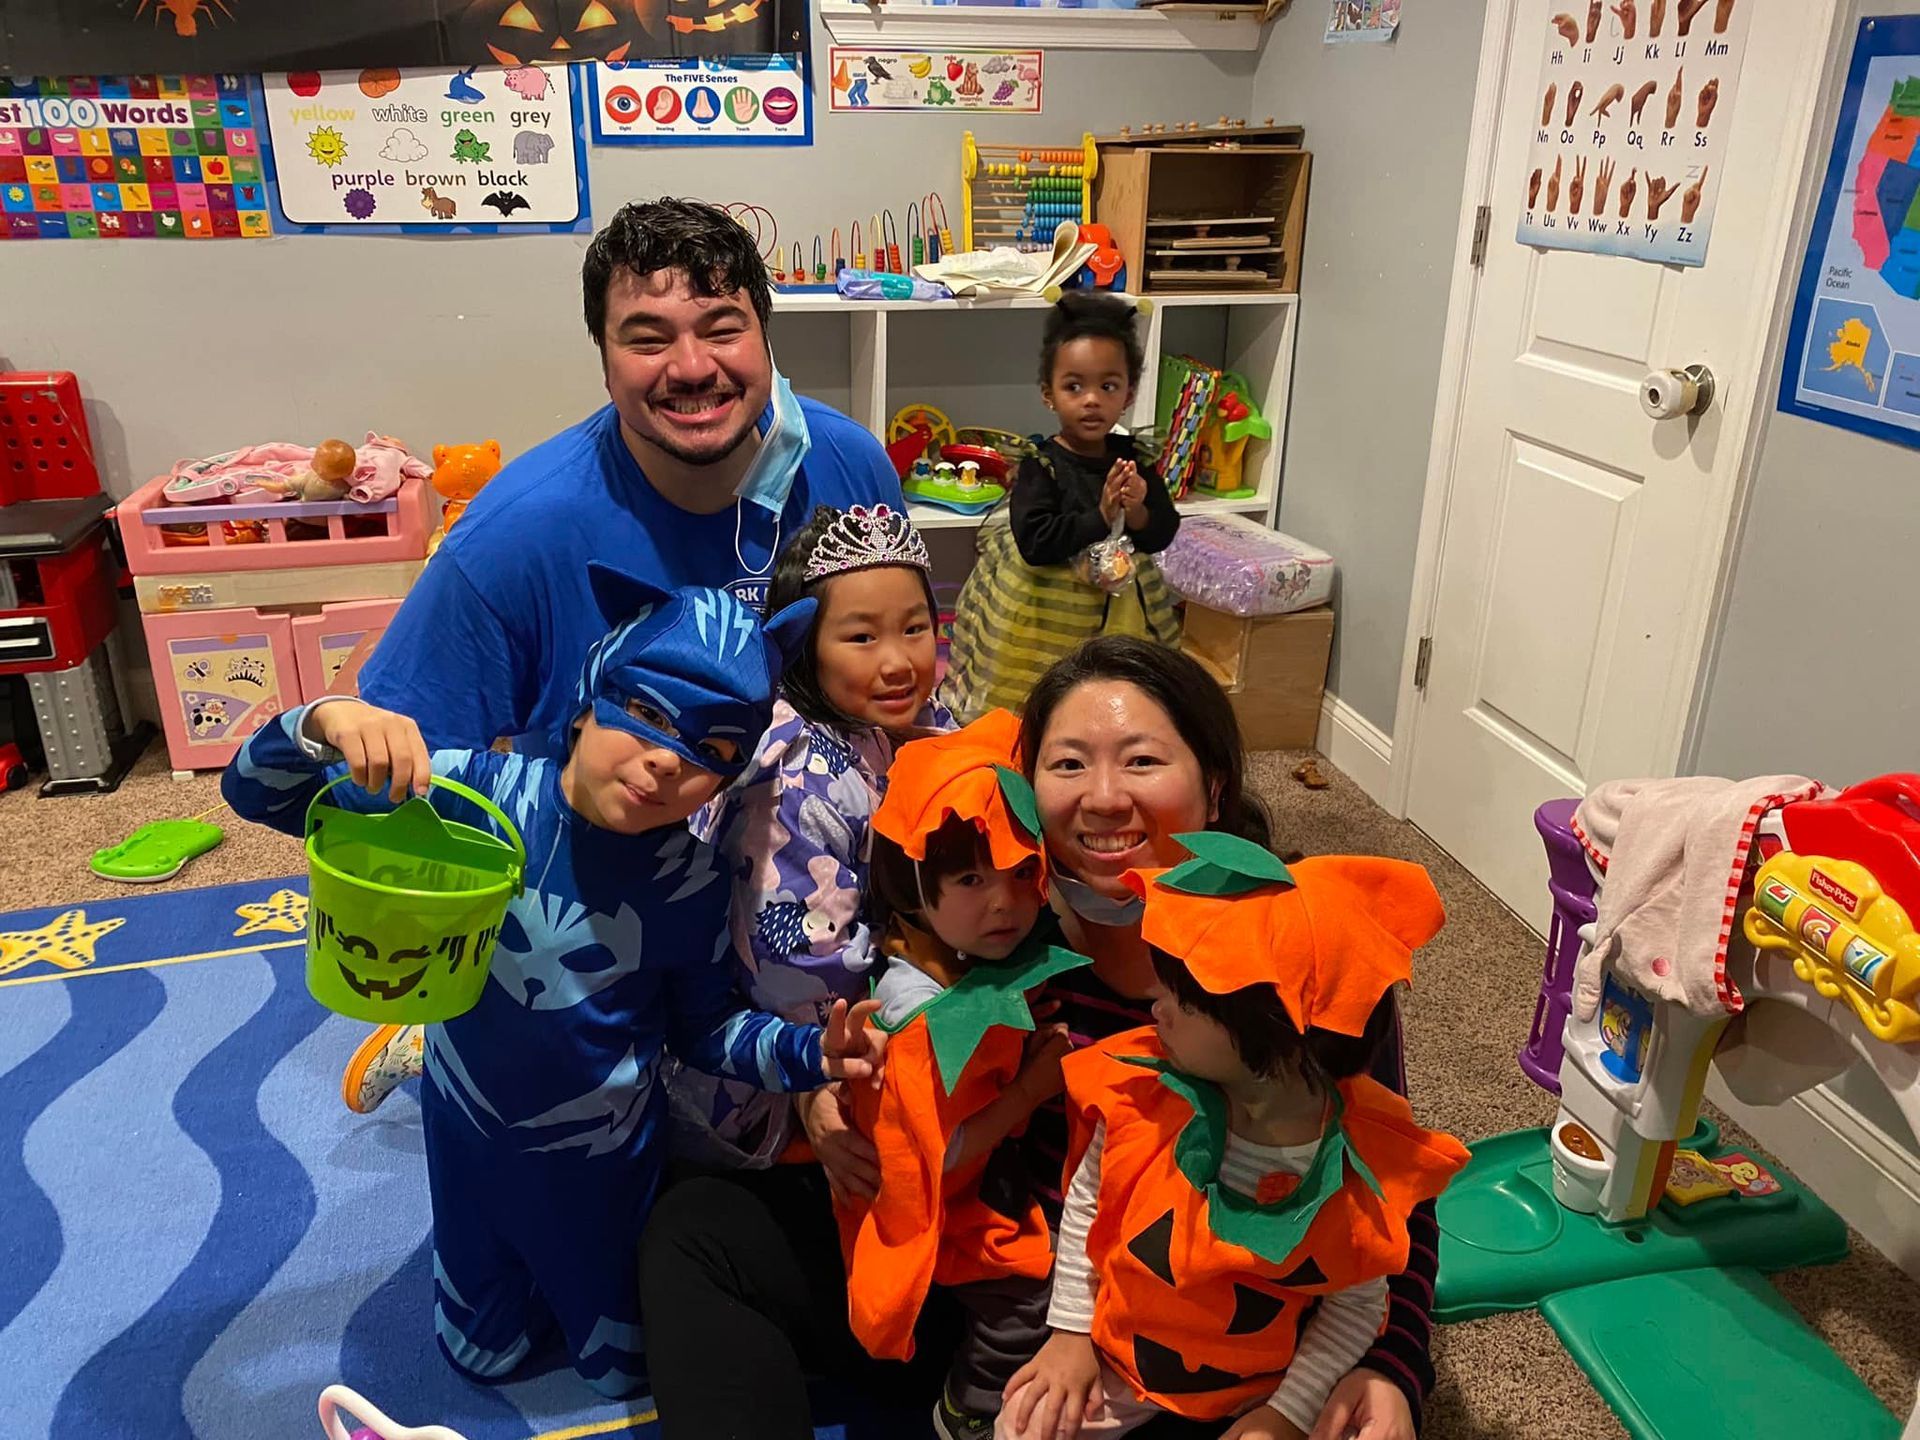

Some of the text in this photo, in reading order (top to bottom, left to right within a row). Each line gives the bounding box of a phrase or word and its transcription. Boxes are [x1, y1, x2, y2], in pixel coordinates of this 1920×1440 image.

[1550, 50, 1563, 65] Hh
[1583, 48, 1591, 63] Ii
[1612, 46, 1625, 65] Jj
[1644, 43, 1660, 60] Kk
[1704, 40, 1729, 56] Mm
[664, 73, 738, 83] The FIVE Senses
[24, 97, 98, 129] 100
[100, 103, 189, 124] Words
[289, 104, 551, 128] yellow white green grey
[1537, 129, 1708, 149] Nn Oo Pp Qq Rr Ss
[331, 169, 529, 189] purple brown black
[1543, 213, 1556, 228] Uu
[1567, 216, 1579, 230] Vv
[1588, 218, 1608, 233] Ww
[1615, 221, 1630, 236] Xx
[1644, 223, 1659, 243] Yy
[1677, 226, 1693, 243] Zz
[1827, 265, 1853, 279] Pacific
[1825, 277, 1851, 290] Ocean
[1811, 871, 1857, 908] Fisher-Price
